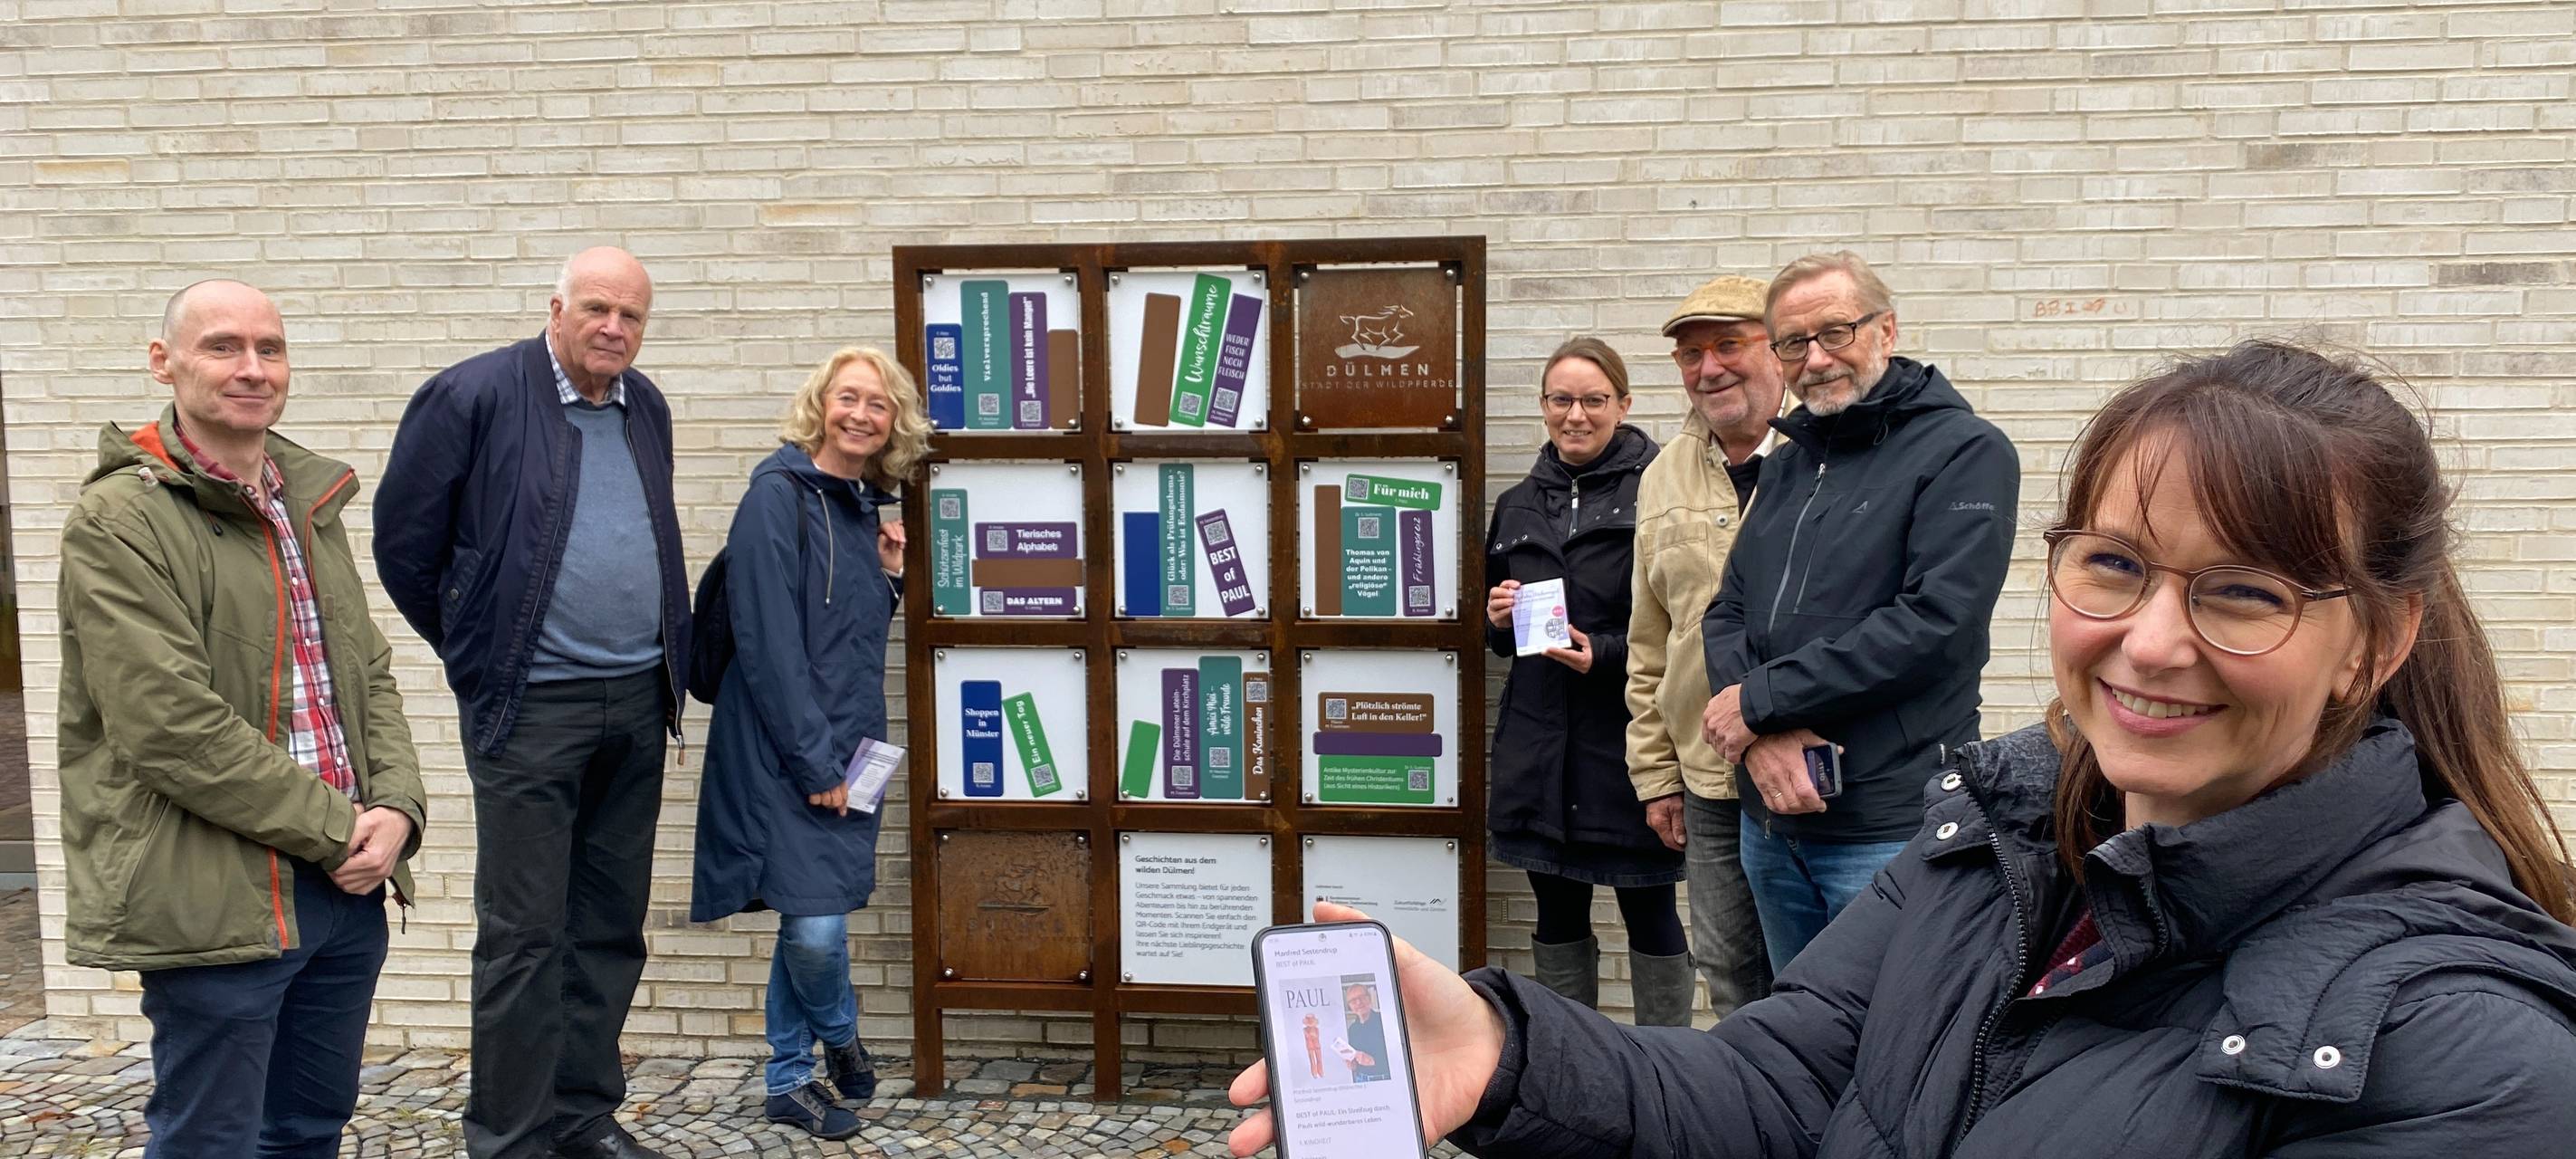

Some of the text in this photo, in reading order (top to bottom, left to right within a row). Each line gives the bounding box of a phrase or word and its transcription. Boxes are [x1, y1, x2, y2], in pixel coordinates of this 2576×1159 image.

[981, 292, 991, 382] Vielversprechend
[1024, 330, 1034, 347] kein
[1226, 333, 1249, 346] WEDER
[1025, 348, 1035, 359] ist
[1225, 345, 1245, 357] FISCH
[932, 364, 959, 372] Oldies
[1224, 356, 1243, 368] NOCH
[1025, 360, 1035, 380] Leere
[1218, 366, 1245, 379] FLEISCH
[1327, 362, 1428, 377] DÜLMEN
[930, 384, 961, 392] Goldies
[1347, 380, 1369, 389] DER
[1376, 379, 1454, 388] WILDPFERDE
[1178, 471, 1186, 525] Eudaimonie?
[1374, 484, 1429, 500] Für mich
[1166, 474, 1175, 540] Prüfungsthema
[1958, 501, 1995, 511] Schöffe
[1016, 529, 1062, 539] Tierisches
[1016, 542, 1058, 553] Alphabet
[1167, 543, 1175, 554] als
[1178, 541, 1187, 558] Was
[951, 534, 967, 588] im Wildpark
[1209, 546, 1236, 566] BEST
[1167, 556, 1175, 581] Glück
[1224, 567, 1236, 582] of
[1221, 585, 1250, 603] PAUL
[1007, 598, 1063, 606] DAS ALTERN
[1219, 683, 1231, 714] Freunde
[1351, 702, 1422, 711] „Plötzlich strömte
[965, 708, 999, 718] Shoppen
[1182, 675, 1191, 761] schule auf dem Kirchplatz
[1351, 713, 1368, 721] Luft
[966, 729, 999, 738] Münster
[1016, 700, 1041, 763] Ein neuer Tag
[1251, 707, 1263, 775] Das Kaninchen
[1135, 855, 1182, 863] Geschichten
[1162, 867, 1195, 875] Dülmen!
[1161, 883, 1197, 891] Sammlung
[1202, 923, 1232, 931] Endgerät
[1274, 949, 1301, 957] Manfred
[1285, 988, 1331, 1009] PAUL
